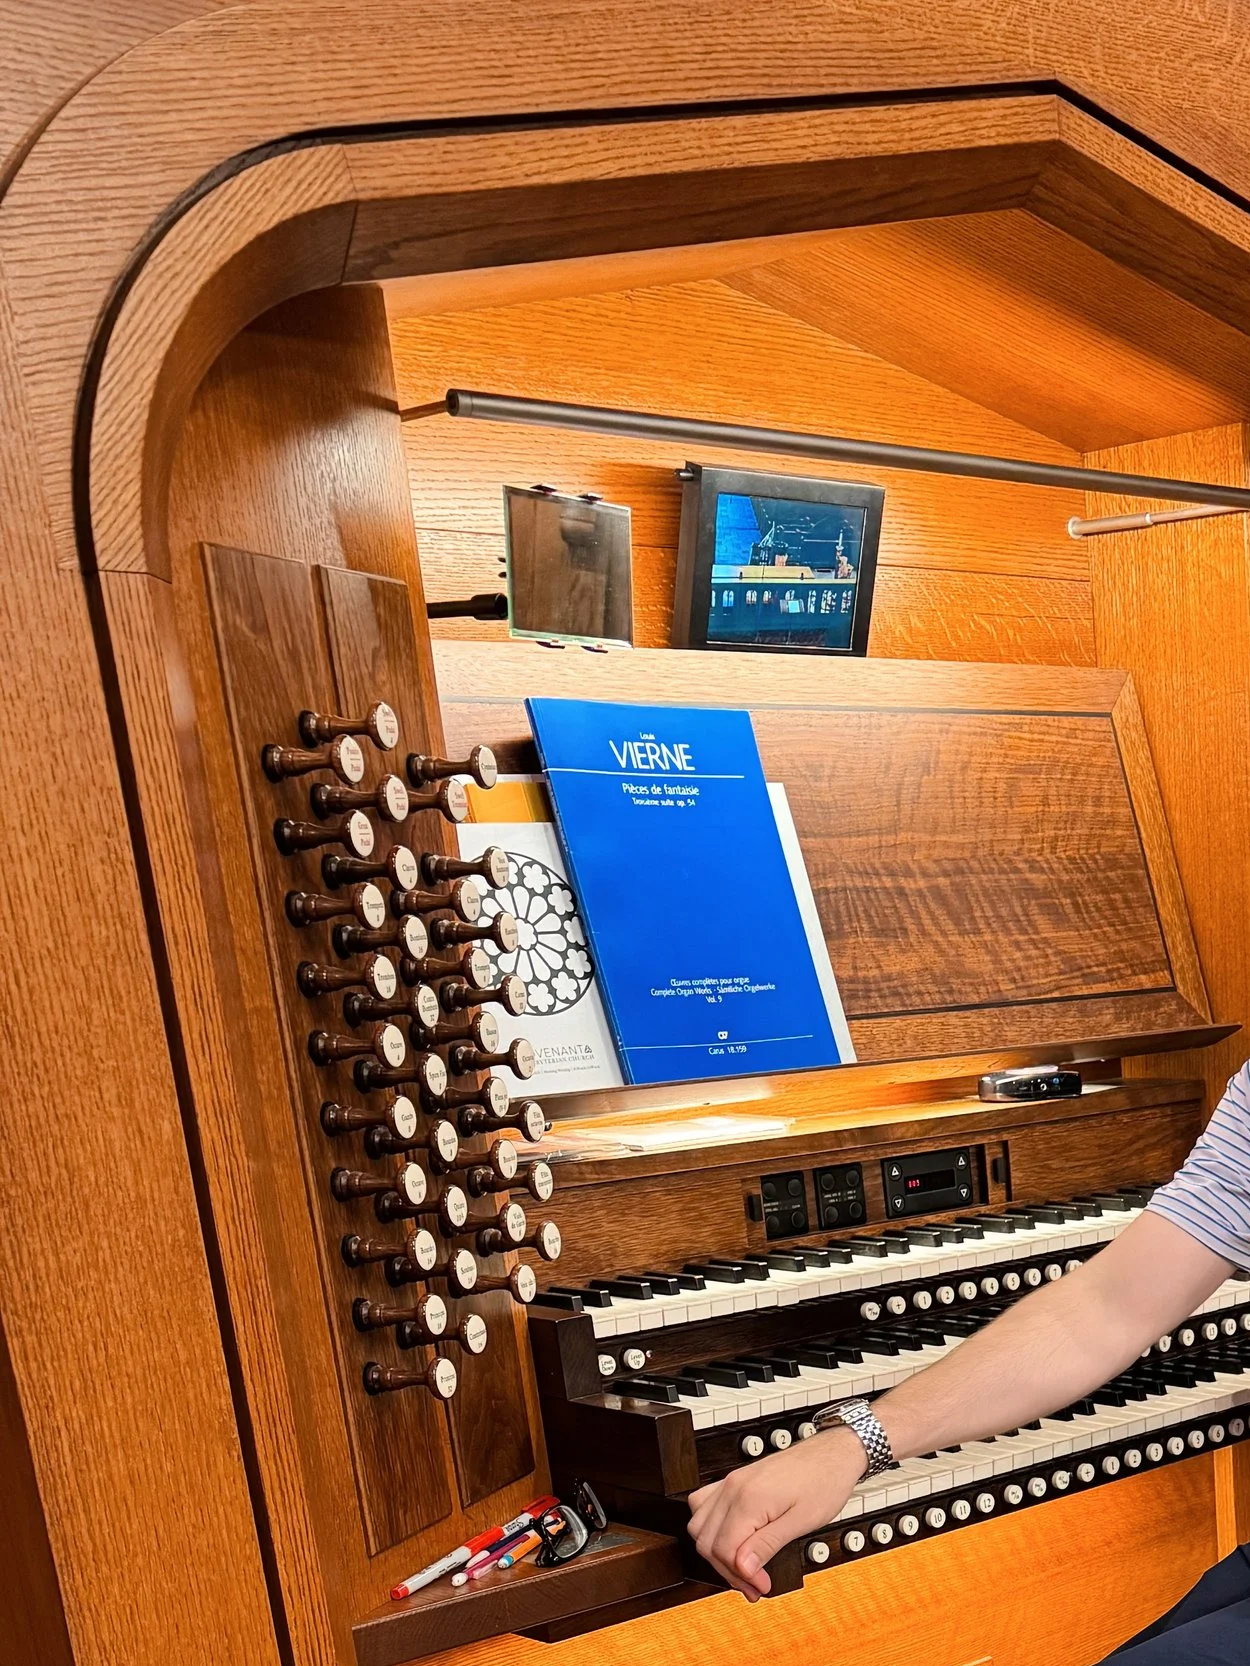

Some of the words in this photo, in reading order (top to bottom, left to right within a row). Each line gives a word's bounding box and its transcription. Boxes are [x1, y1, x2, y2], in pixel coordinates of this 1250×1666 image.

[608, 739, 696, 771] VIERNE
[622, 782, 649, 795] Pièces
[651, 784, 662, 795] de
[663, 784, 700, 796] fantaisie
[718, 995, 723, 1003] 9
[781, 1435, 786, 1444] 2
[754, 1441, 758, 1451] 1
[983, 1498, 991, 1509] 12
[959, 1505, 966, 1515] 11
[934, 1513, 942, 1523] 10
[908, 1521, 913, 1531] 9
[881, 1529, 888, 1539] 8
[854, 1537, 859, 1546] 7
